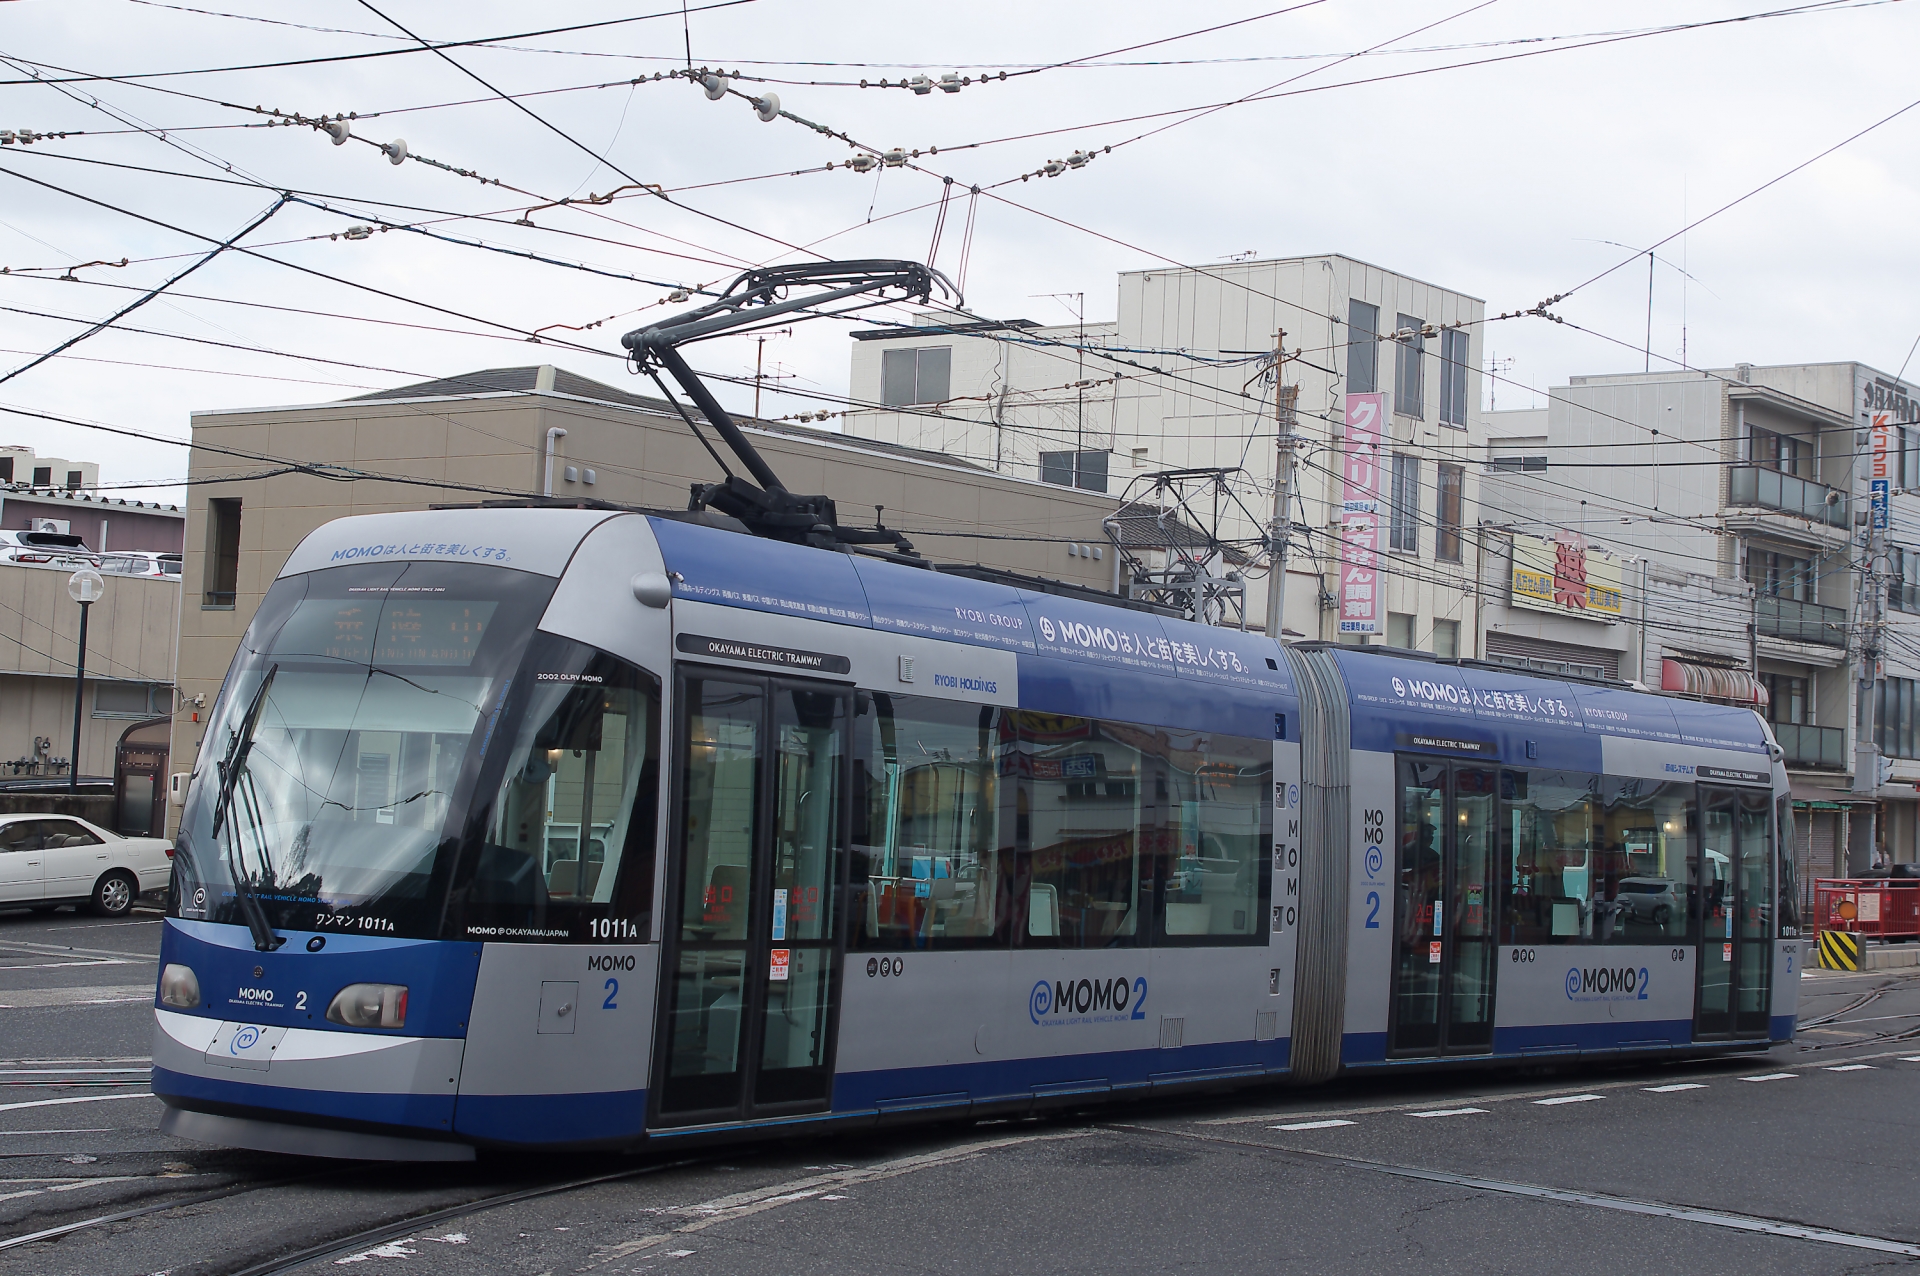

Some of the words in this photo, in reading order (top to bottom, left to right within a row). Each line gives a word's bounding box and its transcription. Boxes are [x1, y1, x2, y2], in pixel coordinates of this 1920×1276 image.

[1350, 401, 1377, 494] クスリ
[330, 543, 512, 562] MOMOは人と街を美しくする。
[1344, 516, 1375, 617] 処方せん調剤
[954, 606, 987, 624] RYOBI
[989, 613, 1023, 630] GROUP
[708, 642, 747, 657] OKAYAMA
[747, 647, 784, 662] ELECTRIC
[786, 652, 822, 666] TRAMWAY
[1058, 619, 1250, 674] MOMOは人と街を美しくする。
[581, 675, 603, 683] MOMO
[934, 674, 958, 688] RYOBI
[1408, 678, 1575, 719] MOMOは人と街を美しくする。
[1584, 706, 1605, 718] RYOBI
[1606, 710, 1628, 721] GROUP
[1413, 737, 1436, 747] OKAYAMA
[1436, 739, 1458, 749] ELECTRIC
[1458, 741, 1481, 751] TRAMWAY
[1364, 809, 1384, 827] MO
[1364, 827, 1384, 845] MO
[274, 894, 297, 902] VEHICLE
[1365, 891, 1380, 929] 2
[1416, 904, 1433, 917] 入口
[1467, 905, 1483, 918] 入口
[316, 913, 355, 927] ワンマン
[357, 916, 394, 931] 1011A
[589, 918, 638, 938] 1011A
[467, 926, 497, 935] MOMO
[505, 927, 569, 938] OKAYAMA/JAPAN
[1782, 945, 1797, 954] MOMO
[587, 955, 636, 971] MOMO
[1786, 957, 1793, 974] 2
[1582, 967, 1637, 994] MOMO
[1637, 967, 1650, 1000] 2
[238, 987, 274, 1002] MOMO
[295, 990, 308, 1010] 2
[602, 977, 619, 1010] 2
[1054, 977, 1130, 1014] MOMO
[1130, 976, 1148, 1020] 2
[1066, 1018, 1080, 1026] LIGHT
